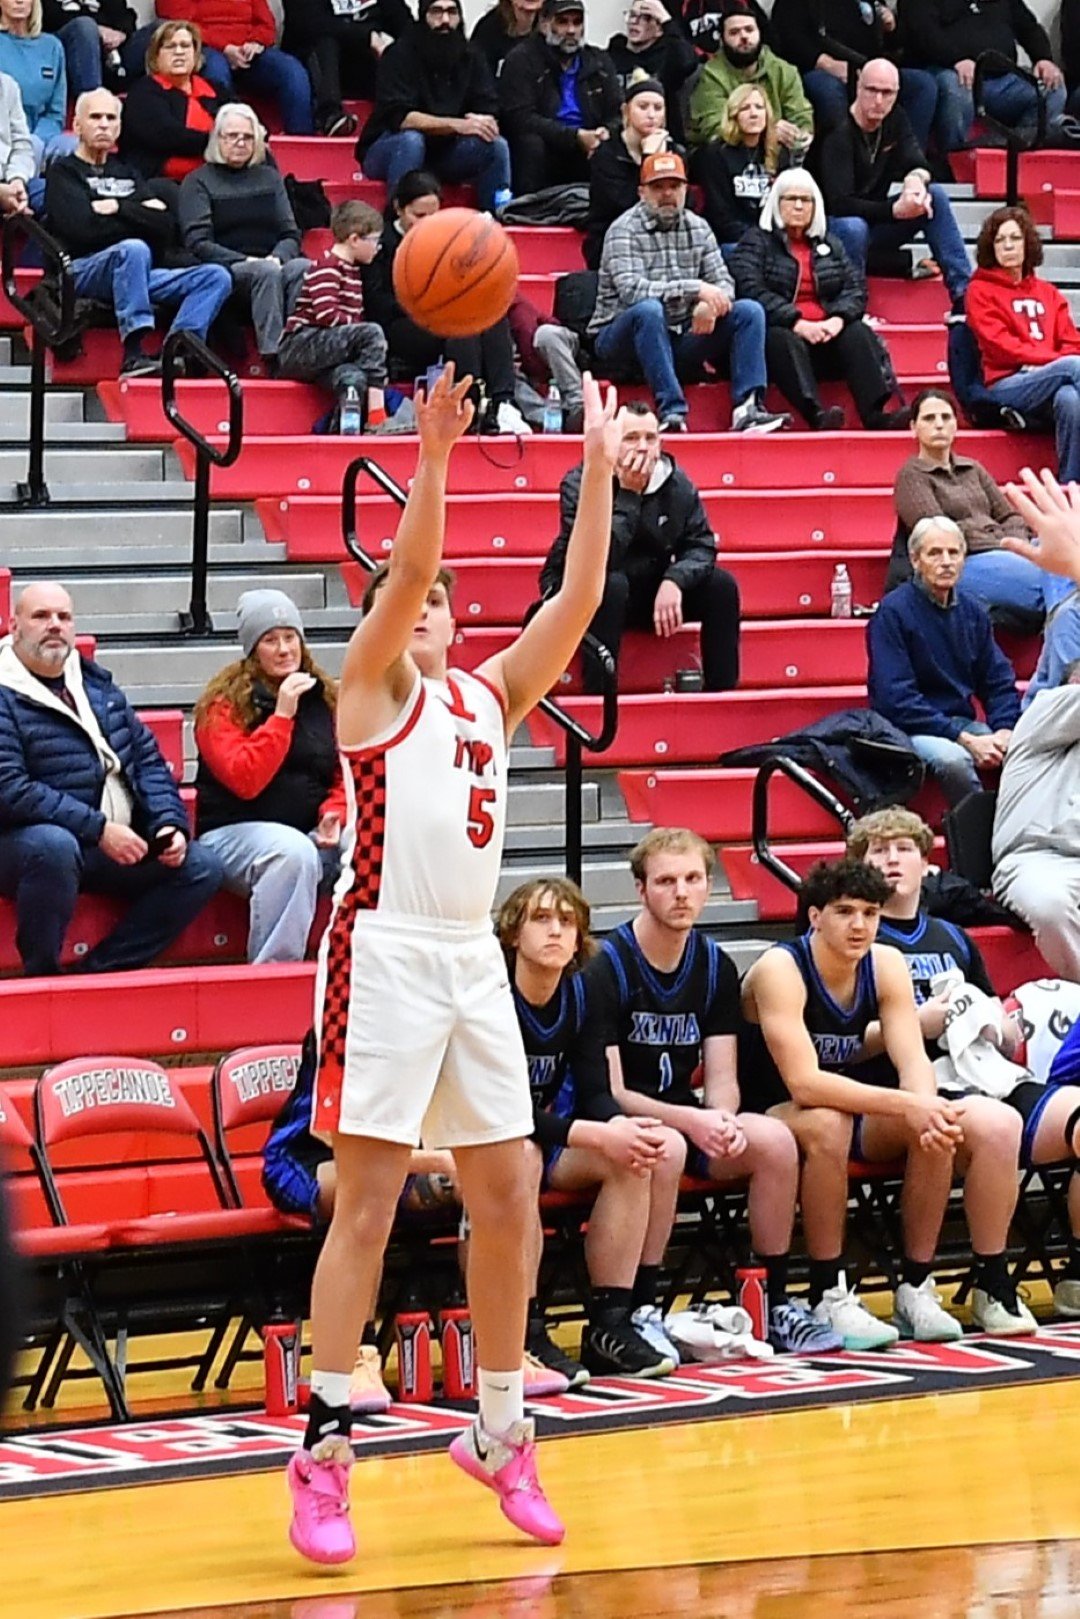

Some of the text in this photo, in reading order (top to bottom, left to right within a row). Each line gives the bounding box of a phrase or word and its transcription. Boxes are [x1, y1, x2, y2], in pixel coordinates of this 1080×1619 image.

[467, 785, 497, 849] 5
[628, 1011, 700, 1046] XENIA
[53, 1068, 175, 1117] TIPPECANOE
[658, 1052, 673, 1093] 1
